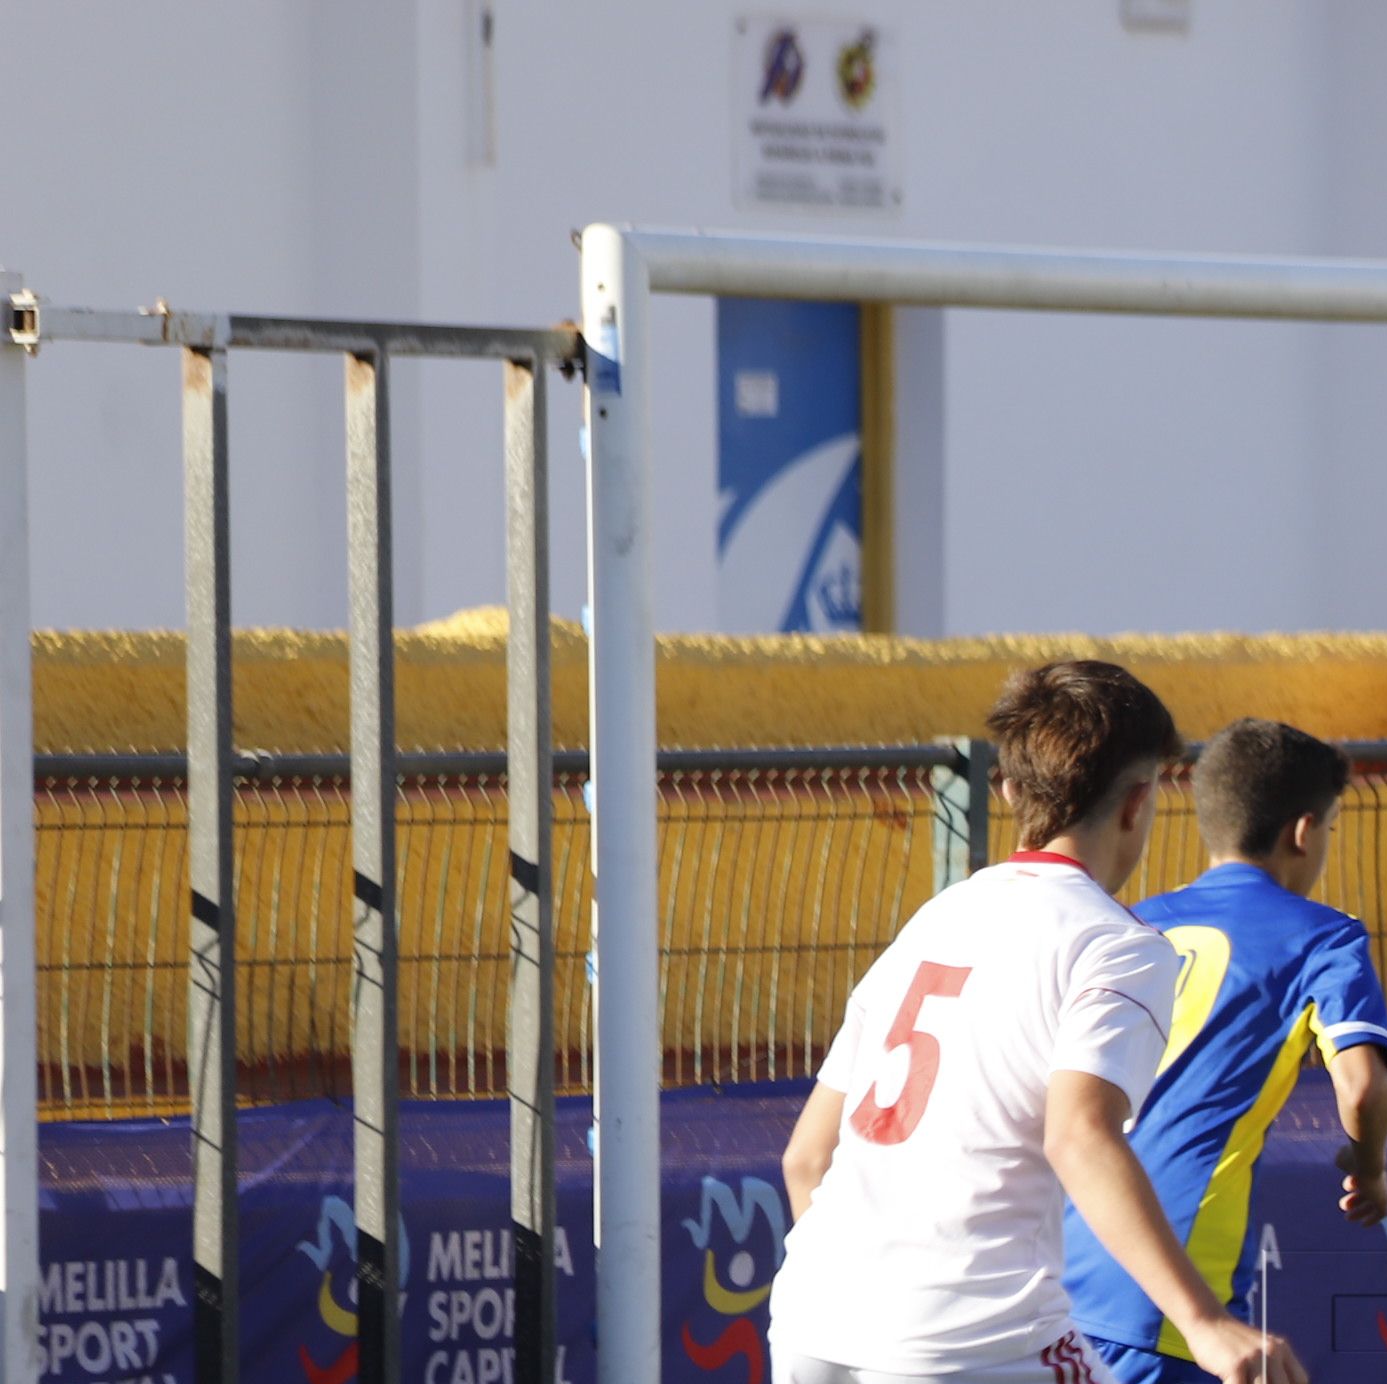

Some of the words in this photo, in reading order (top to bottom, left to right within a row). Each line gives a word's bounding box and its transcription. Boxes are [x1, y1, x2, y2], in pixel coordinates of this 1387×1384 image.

[850, 960, 973, 1146] 5
[427, 1226, 575, 1282] MELIA
[37, 1257, 187, 1314] MELILLA
